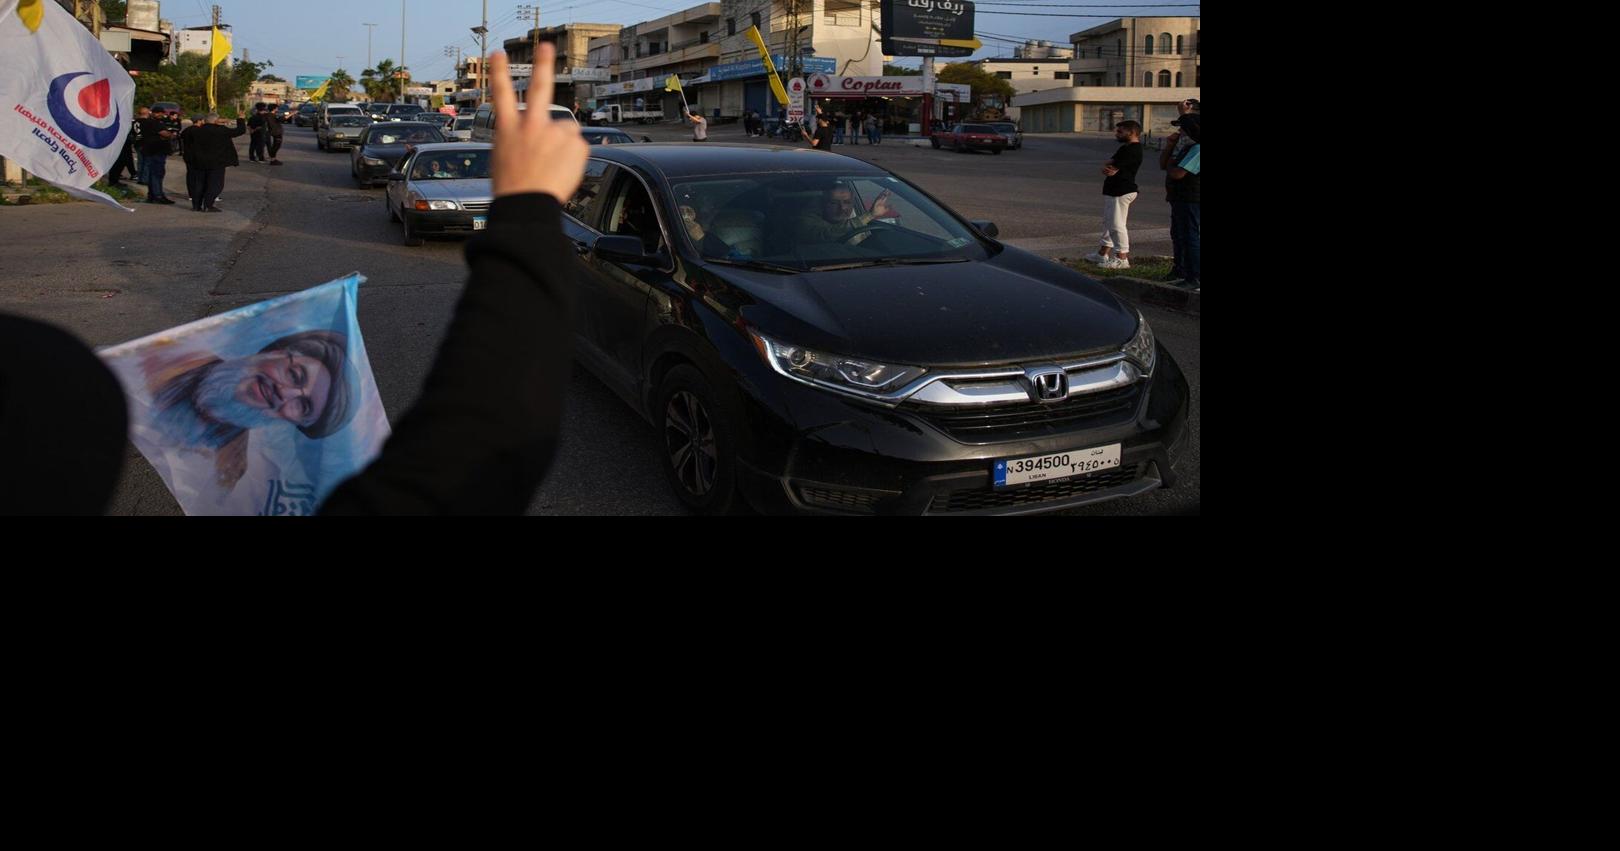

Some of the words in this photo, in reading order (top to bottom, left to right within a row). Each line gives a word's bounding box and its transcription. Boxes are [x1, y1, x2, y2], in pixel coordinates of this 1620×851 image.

[842, 77, 903, 94] Coptan
[1006, 466, 1014, 474] N
[1015, 454, 1070, 473] 394500
